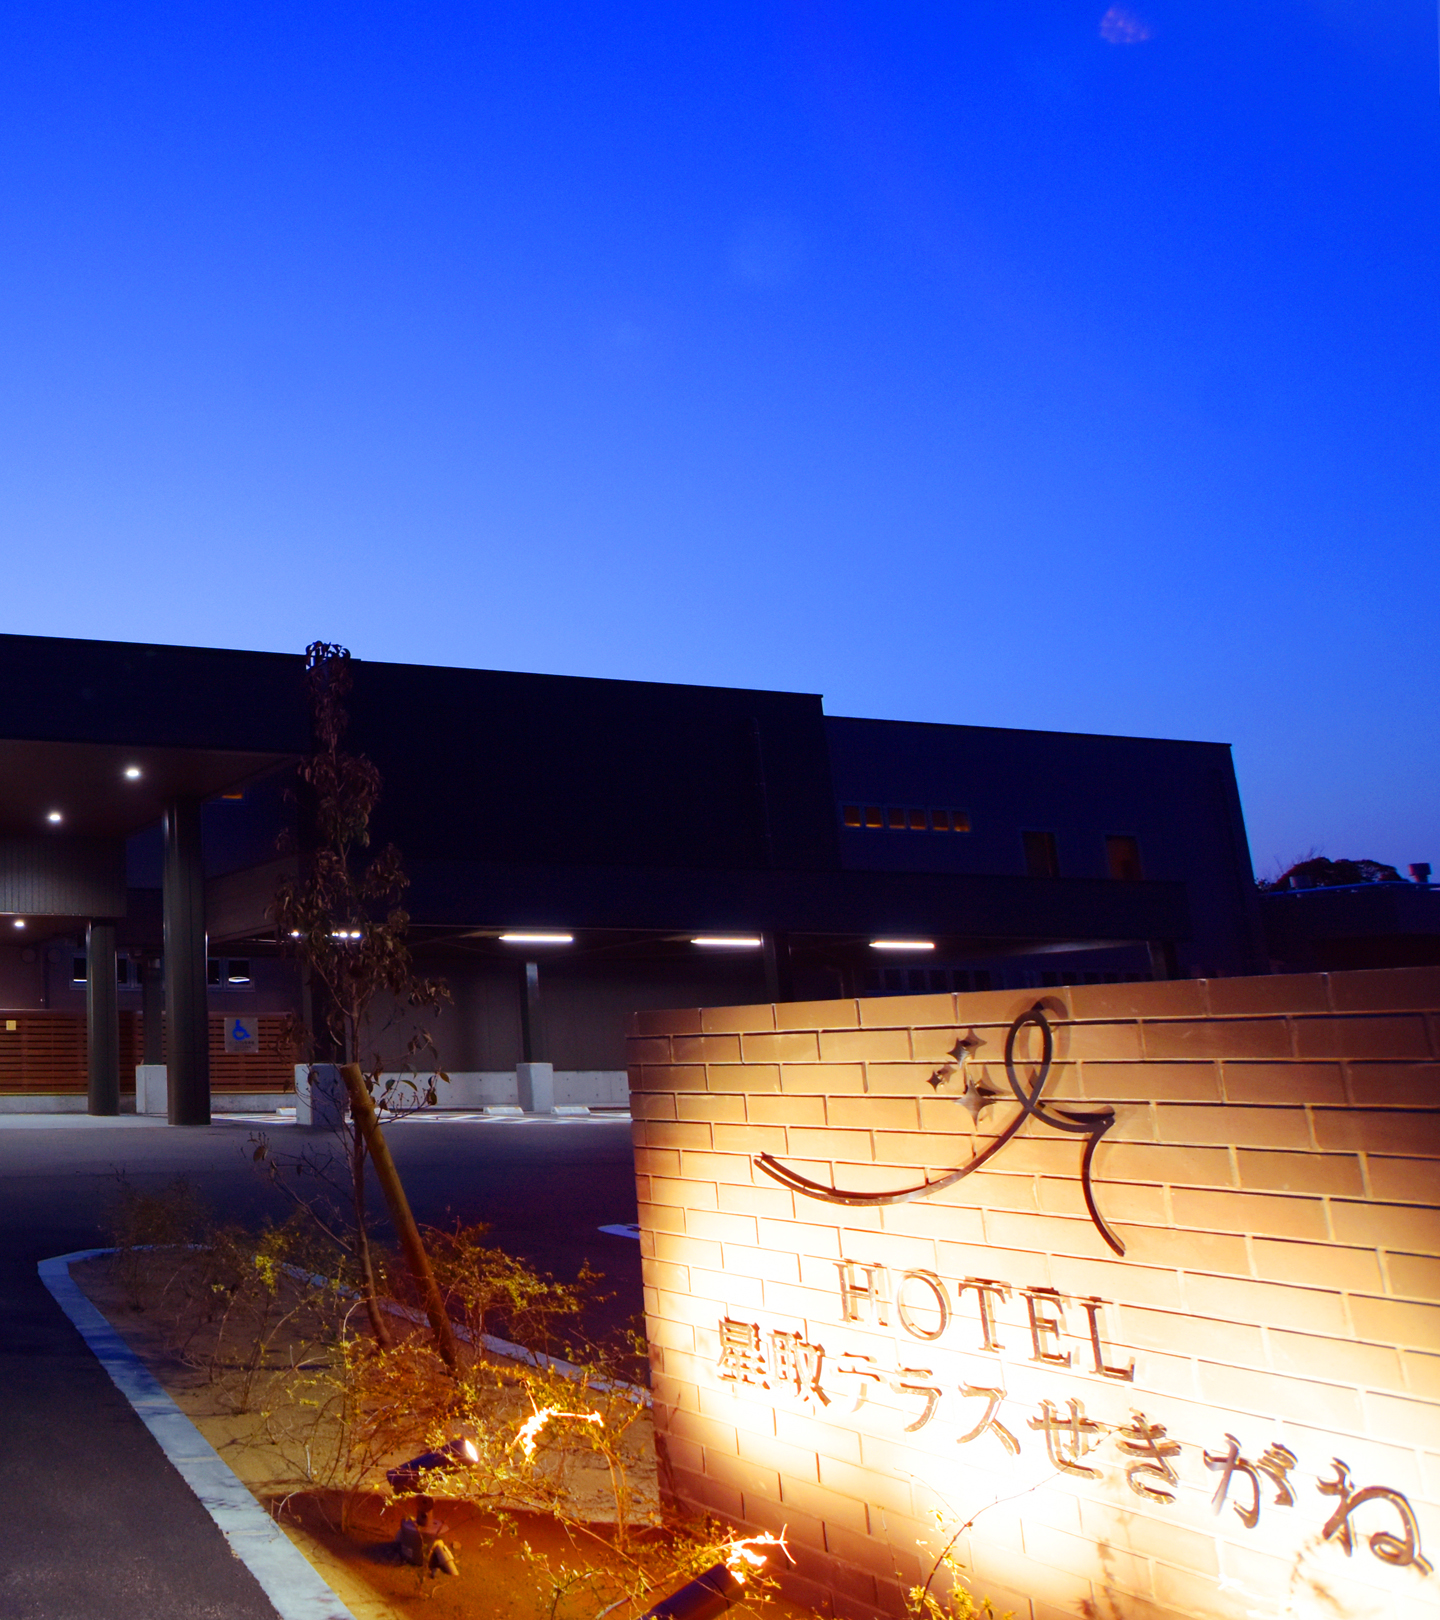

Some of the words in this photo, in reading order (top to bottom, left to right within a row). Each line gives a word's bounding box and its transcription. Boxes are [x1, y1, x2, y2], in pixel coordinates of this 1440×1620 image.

[833, 1259, 1135, 1382] HOTEL
[717, 1317, 1434, 1576] 星取テラスせきがね
